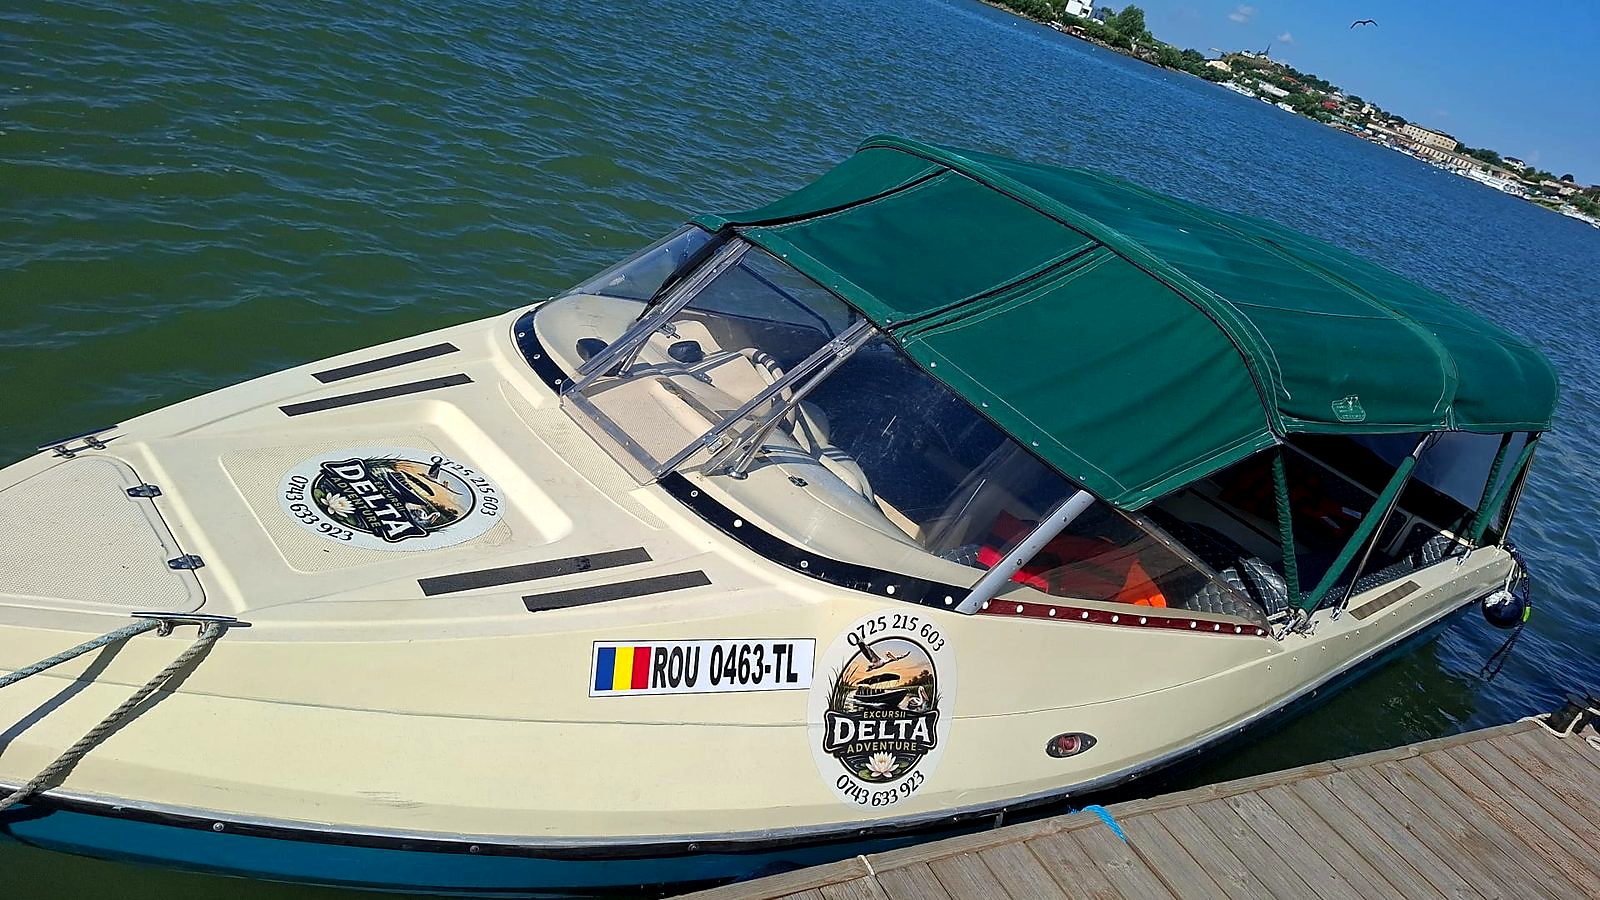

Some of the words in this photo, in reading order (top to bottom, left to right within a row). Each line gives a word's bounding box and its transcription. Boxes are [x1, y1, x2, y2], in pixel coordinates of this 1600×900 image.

[430, 455, 474, 476] 0725
[285, 476, 309, 500] 0743
[374, 481, 405, 512] EXCURSII
[470, 477, 495, 493] 215
[331, 477, 381, 528] ADVENTURE
[332, 464, 414, 537] DELTA
[480, 496, 499, 516] 603
[290, 504, 320, 525] 633
[316, 523, 354, 541] 923
[847, 615, 887, 646] 0725
[893, 613, 919, 631] 215
[920, 623, 945, 652] 603
[652, 646, 700, 689] ROU
[709, 643, 799, 686] 0463-TL
[863, 710, 906, 719] EXCURSII
[832, 716, 931, 746] DELTA
[847, 741, 917, 754] ADVENTURE
[836, 774, 870, 805] 0743
[871, 789, 899, 807] 633
[900, 770, 925, 798] 923
